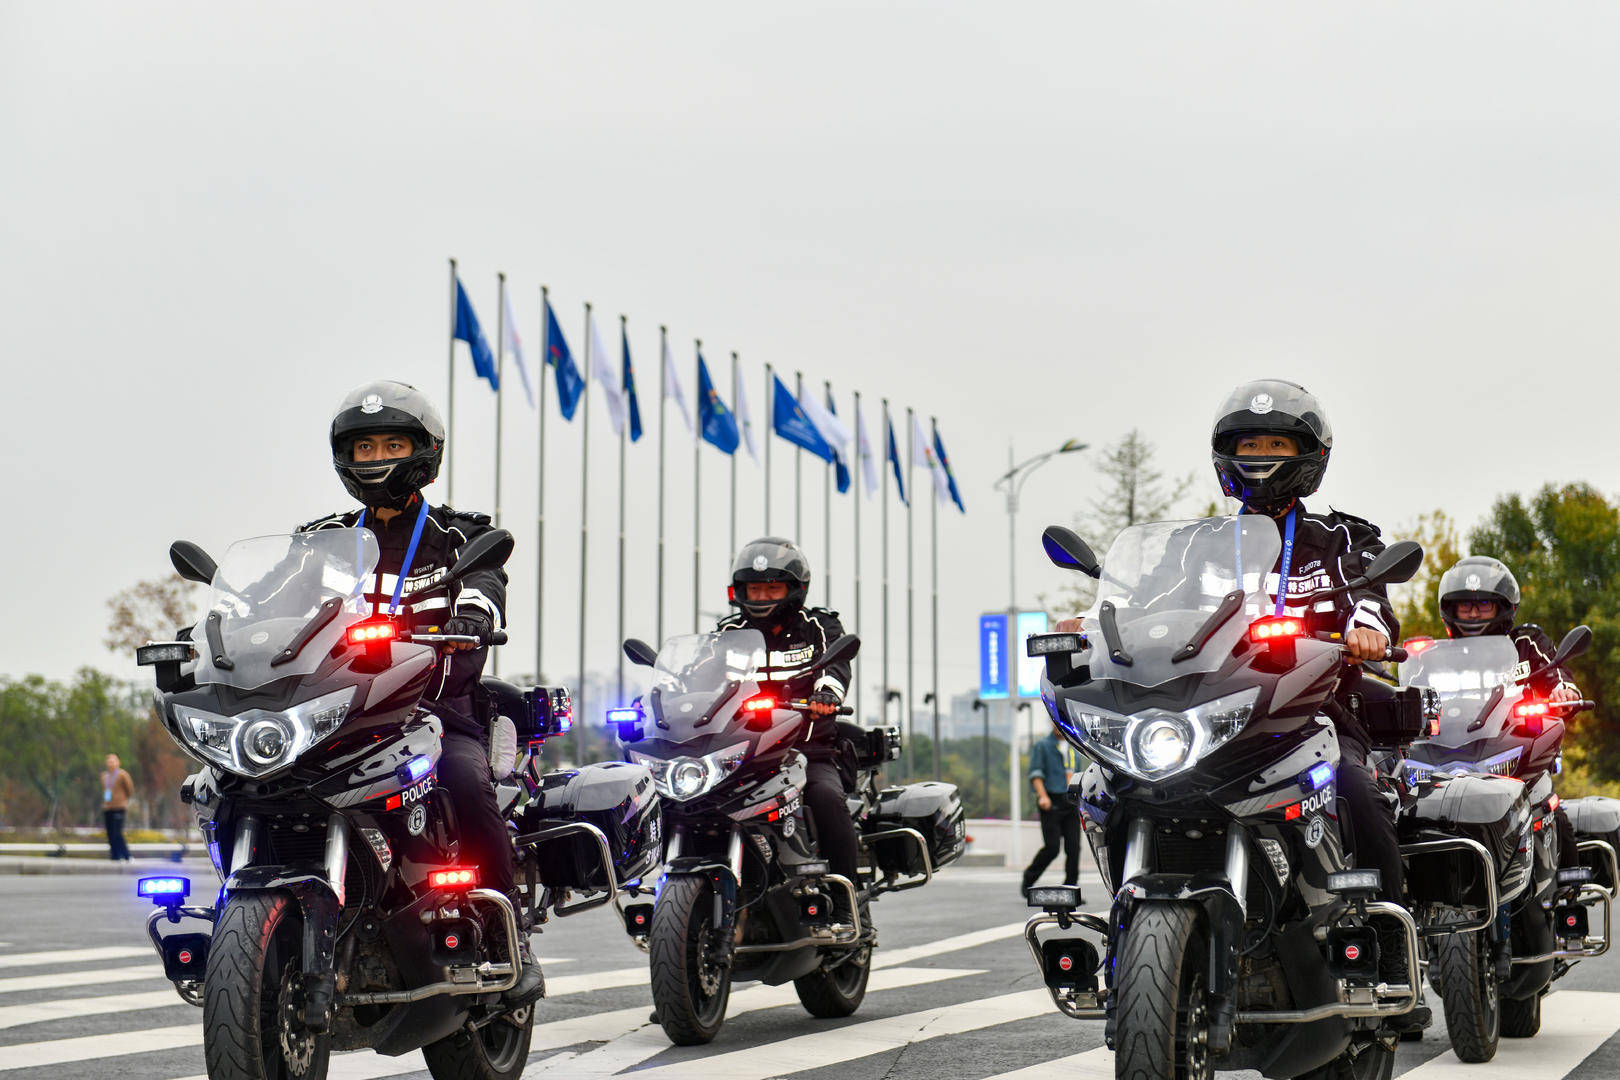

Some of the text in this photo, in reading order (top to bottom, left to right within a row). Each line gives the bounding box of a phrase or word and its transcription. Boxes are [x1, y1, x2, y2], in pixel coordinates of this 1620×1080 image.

[402, 776, 433, 806] POLICE
[1301, 785, 1332, 816] POLICE
[778, 798, 800, 818] POLICE
